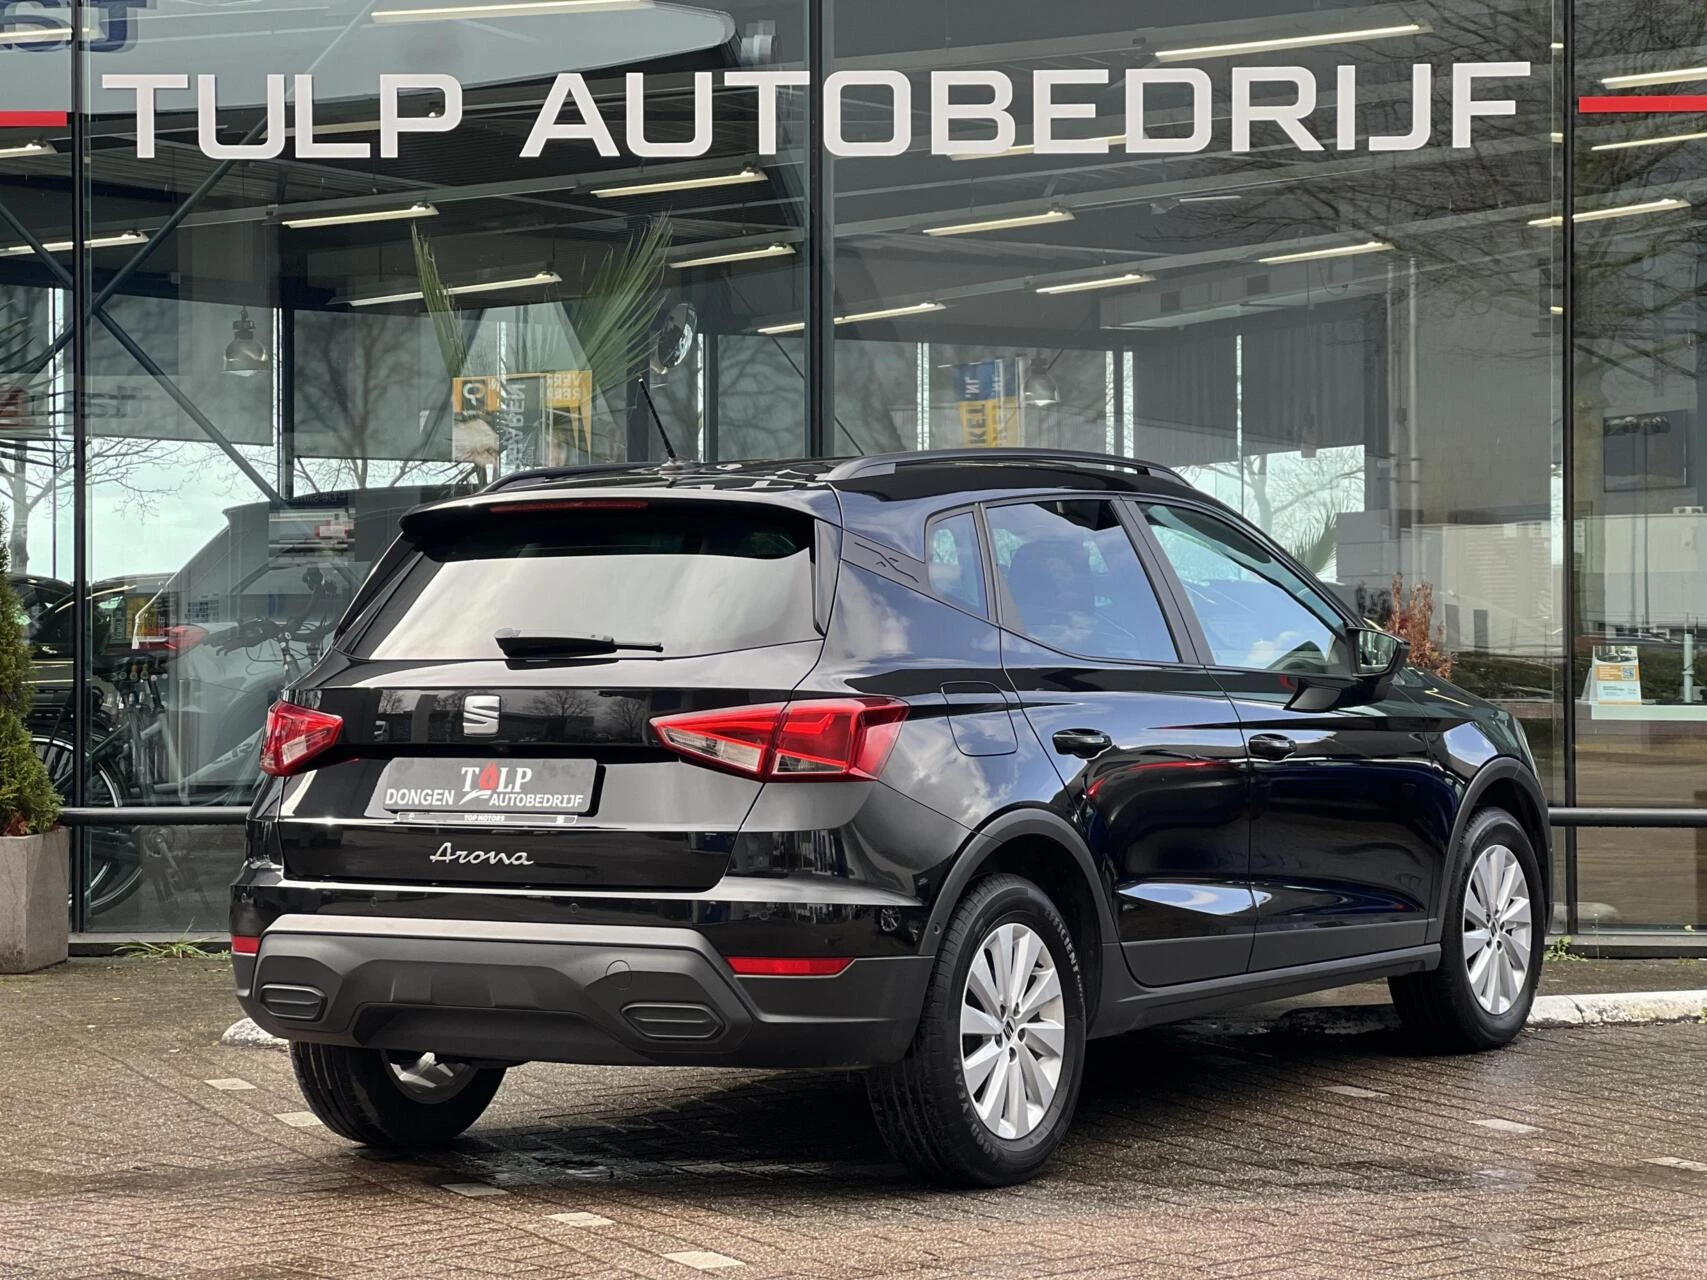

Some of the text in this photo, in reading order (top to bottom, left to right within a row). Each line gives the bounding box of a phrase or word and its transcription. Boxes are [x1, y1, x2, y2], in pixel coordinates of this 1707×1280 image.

[102, 61, 1532, 160] TULP AUTOBEDRIJF
[385, 788, 583, 807] DONGEN AUTOBEDRIJF
[430, 842, 534, 865] Arona
